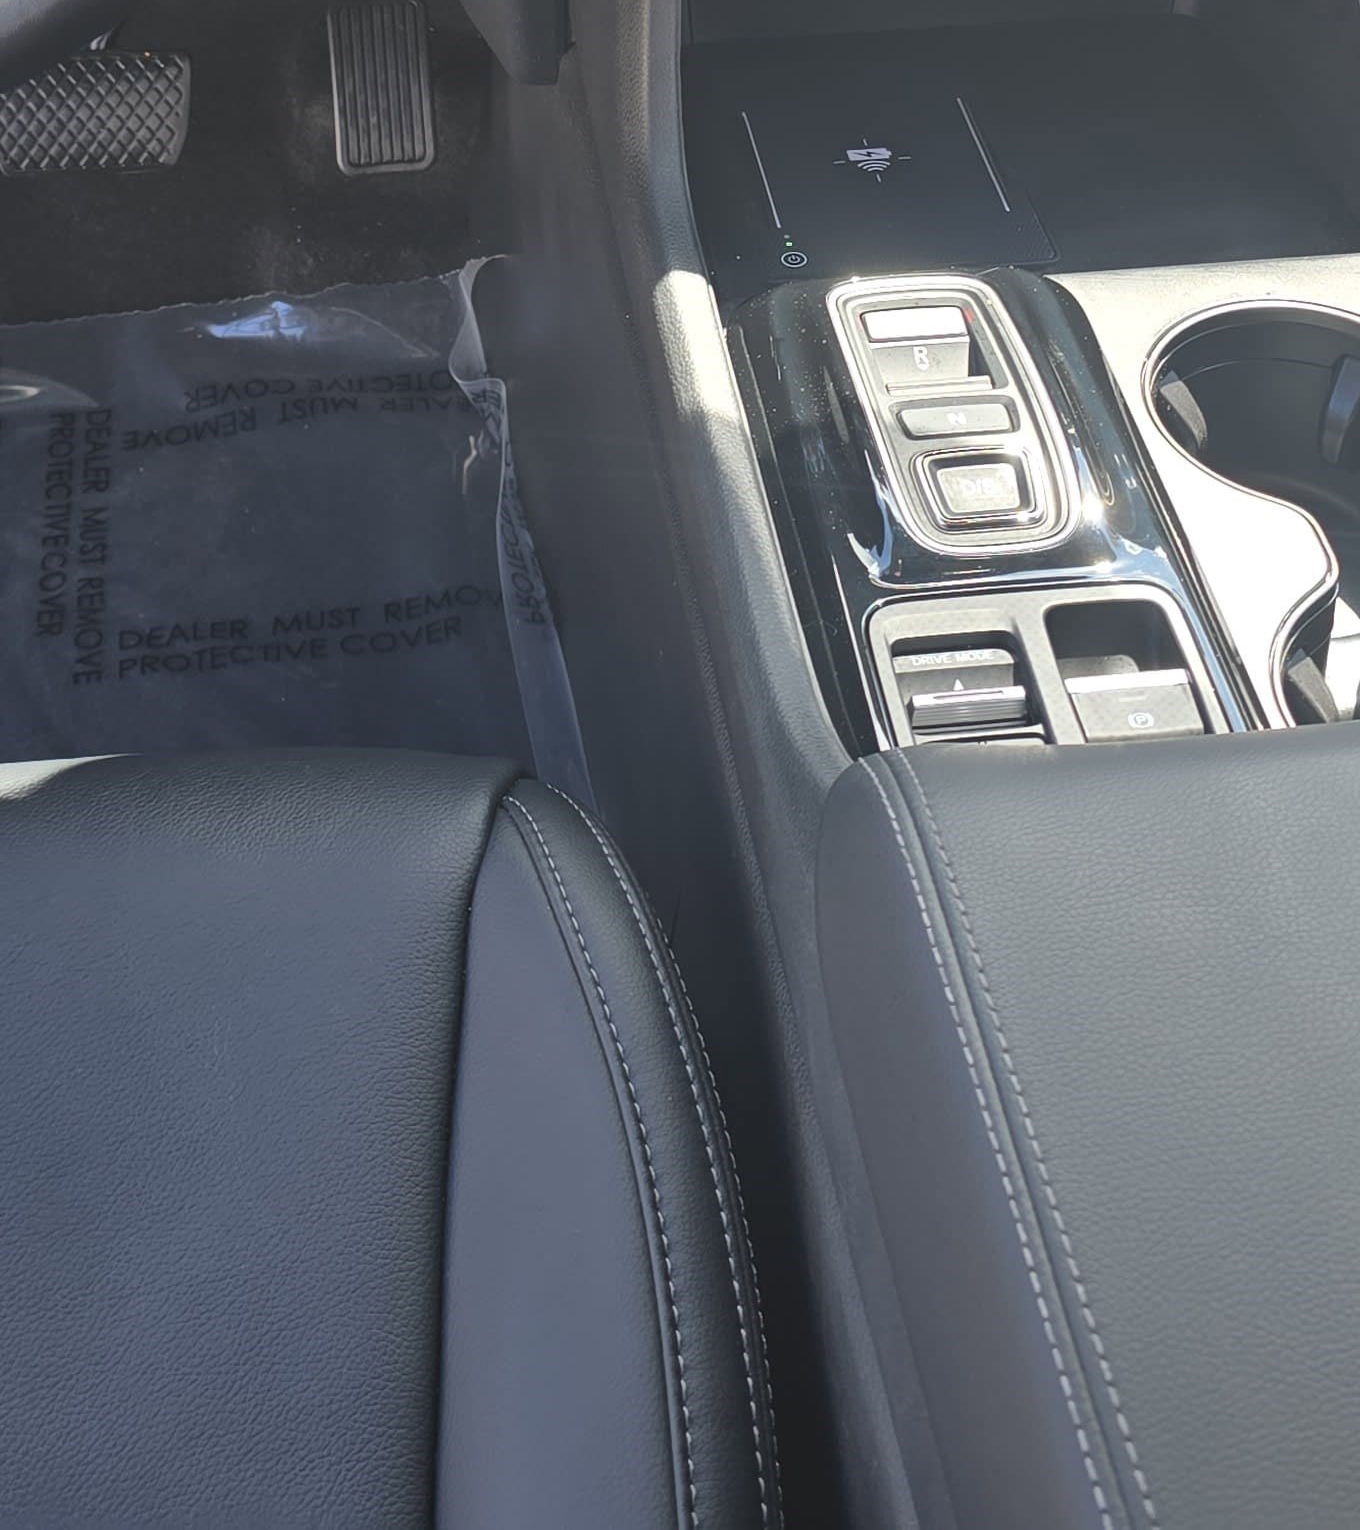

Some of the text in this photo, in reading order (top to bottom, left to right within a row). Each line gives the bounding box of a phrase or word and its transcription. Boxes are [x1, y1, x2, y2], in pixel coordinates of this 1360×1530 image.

[913, 345, 928, 363] R
[184, 377, 297, 413] COVER
[277, 396, 359, 424] MUST
[119, 406, 257, 451] REMOVE
[946, 412, 968, 425] N
[32, 411, 76, 639] PROTECTIVE COVER
[72, 408, 113, 687] DEALER MUST REMOVE
[116, 583, 503, 652] DEALER MUST REMOV
[116, 615, 464, 680] PROTECTIVE COVER
[911, 651, 995, 666] DRIVE MODE
